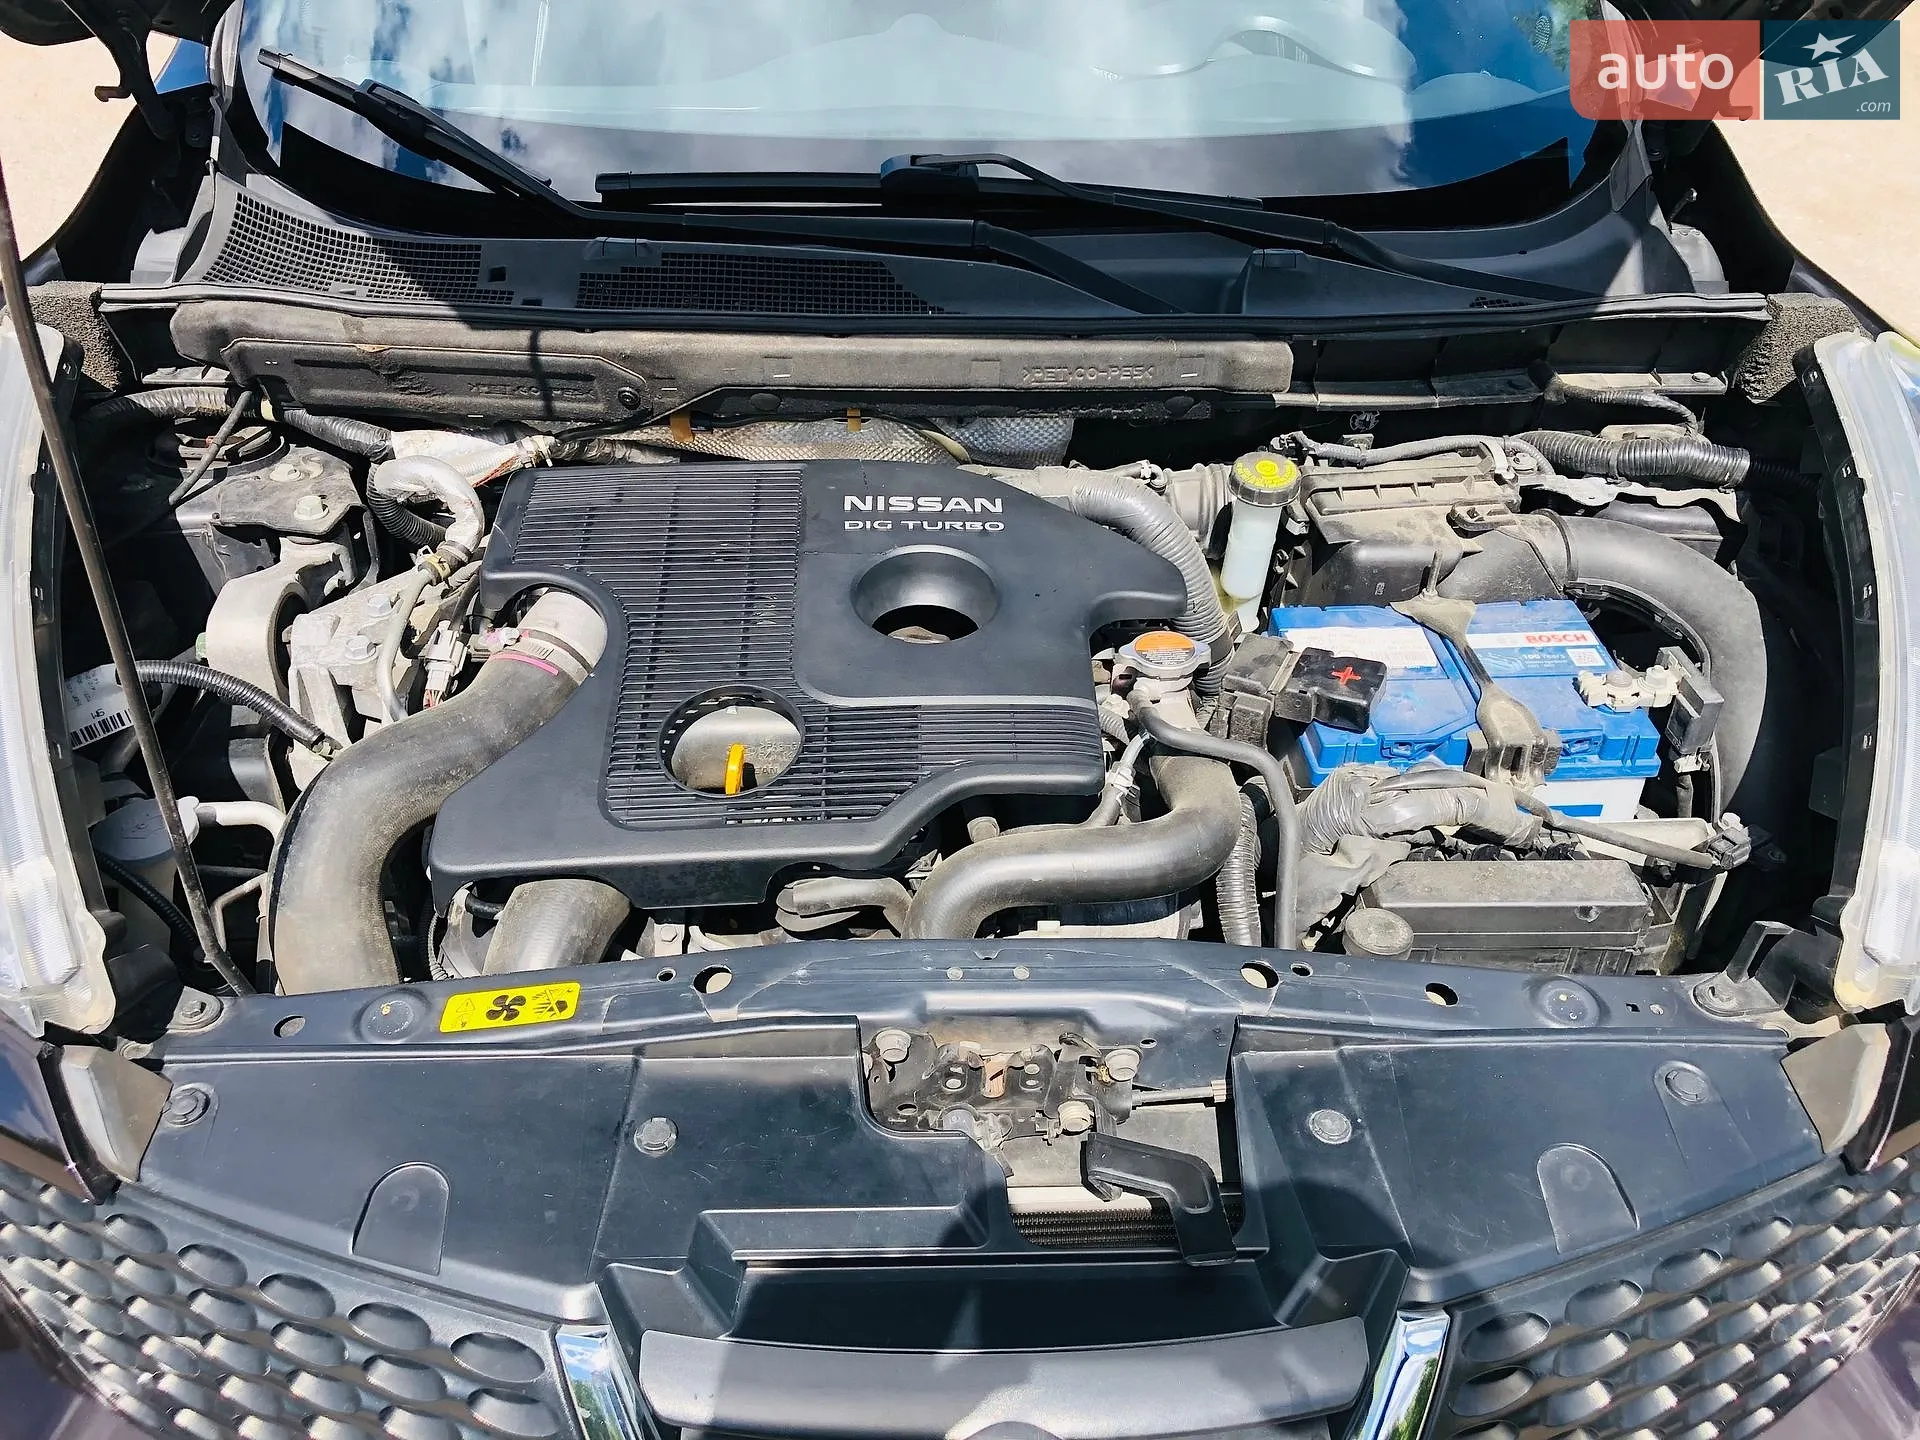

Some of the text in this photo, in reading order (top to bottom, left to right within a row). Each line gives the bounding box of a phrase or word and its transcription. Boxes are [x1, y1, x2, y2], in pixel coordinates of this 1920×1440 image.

[843, 495, 1003, 513] NISSAN
[844, 520, 1005, 532] DIG TURBO
[1525, 633, 1588, 644] BOSCH
